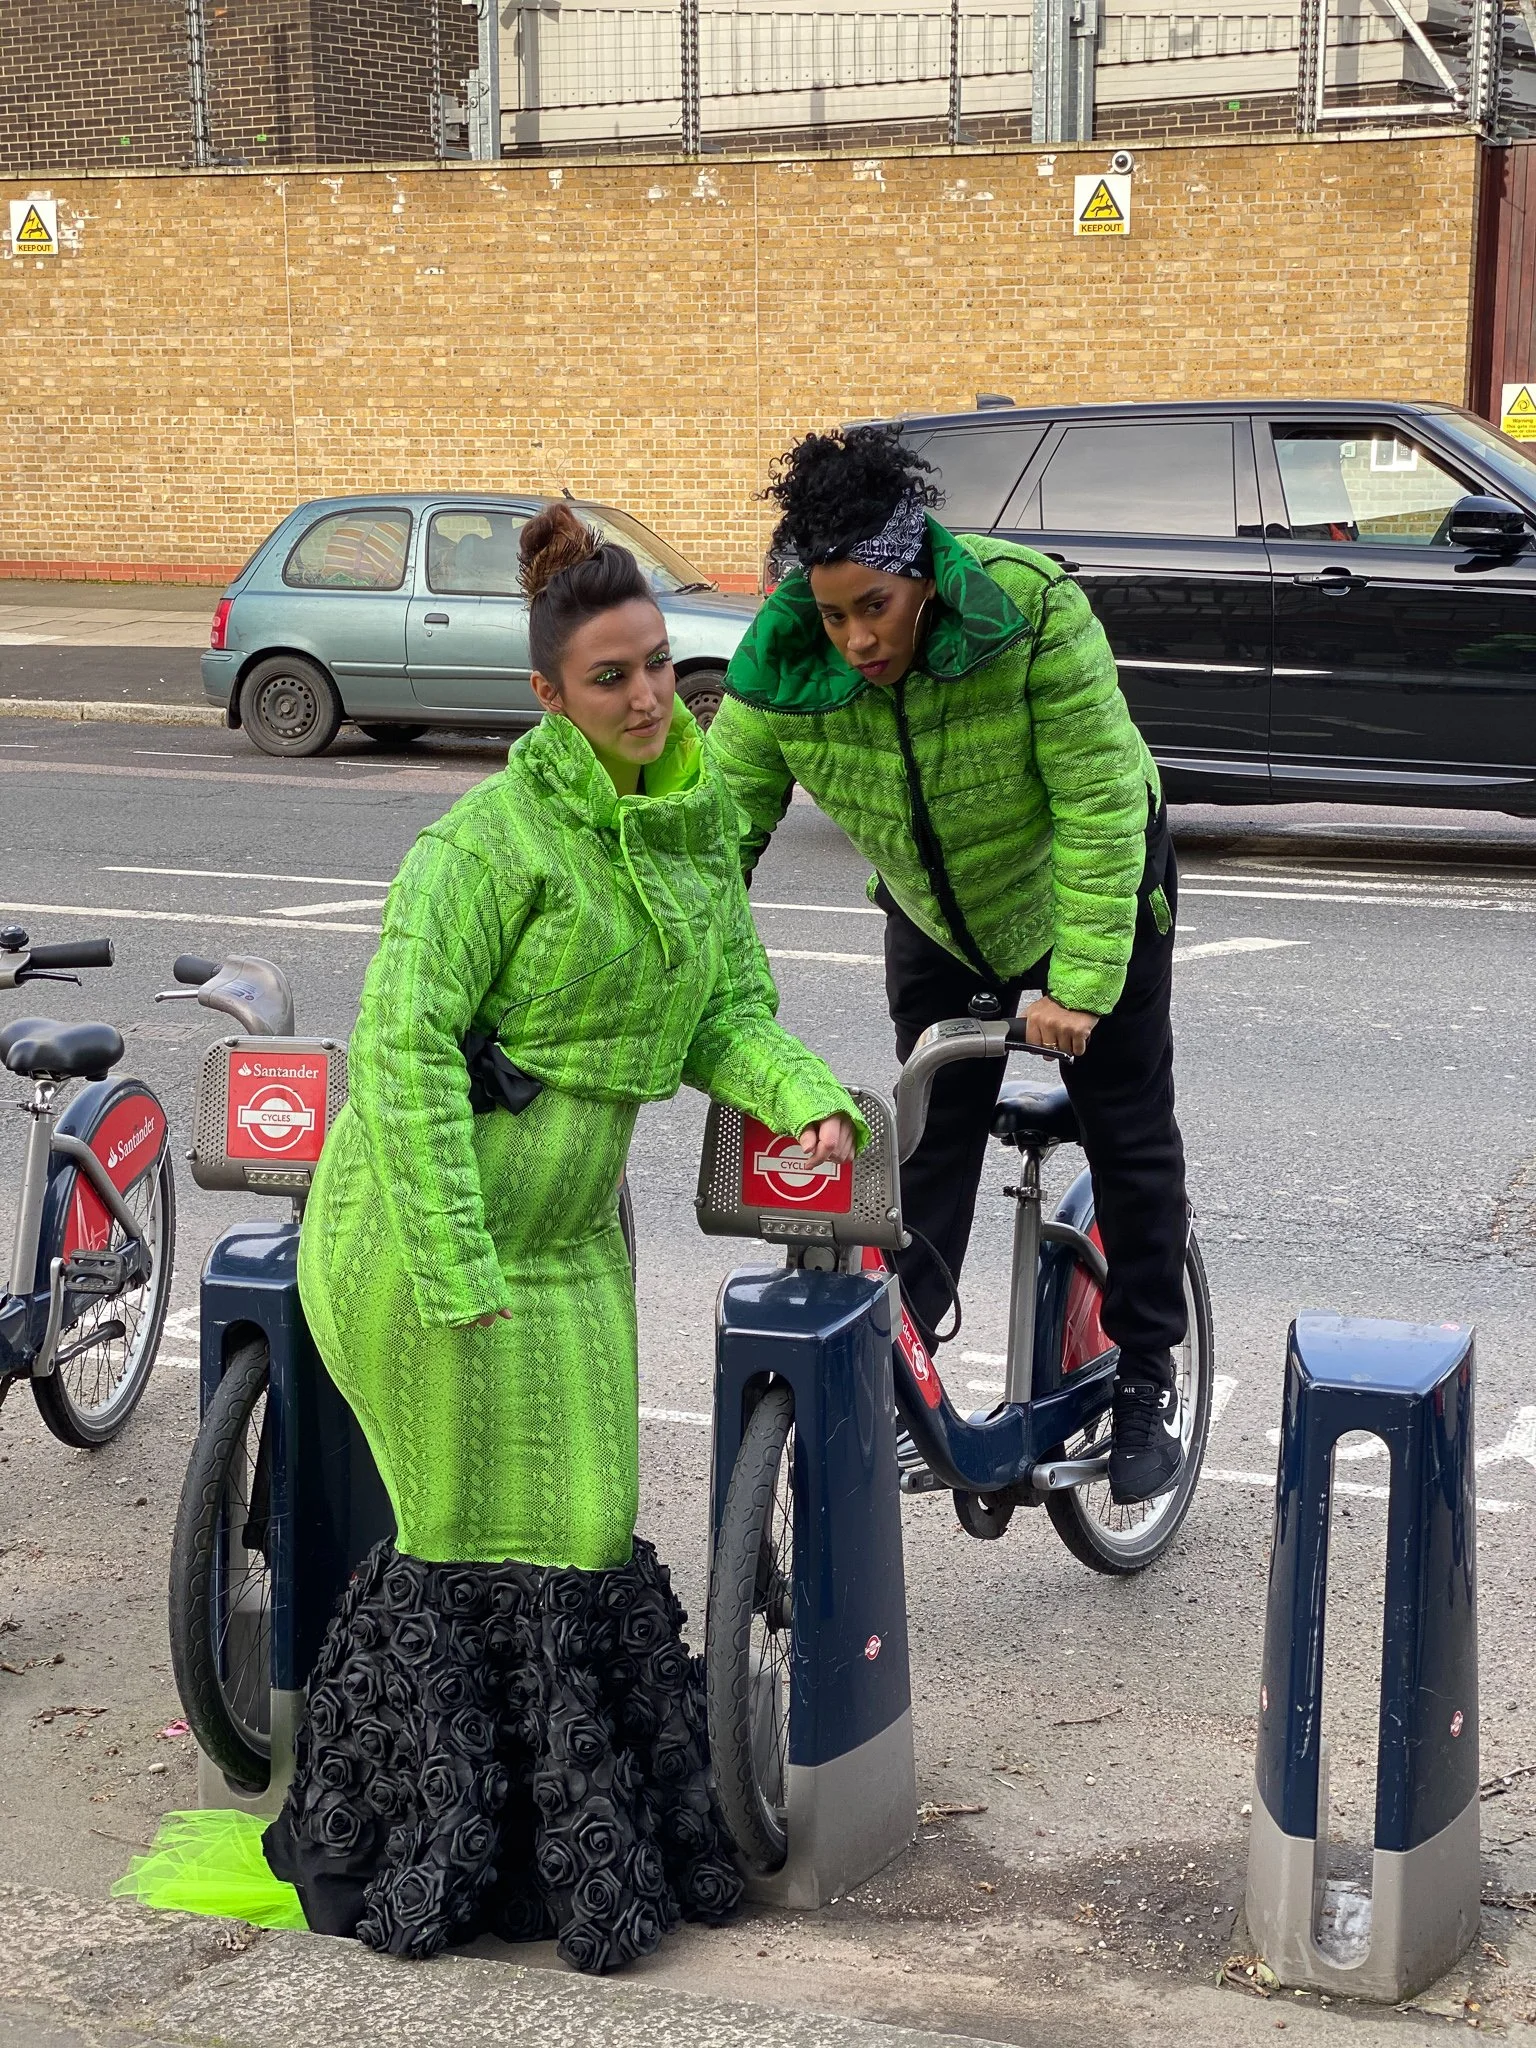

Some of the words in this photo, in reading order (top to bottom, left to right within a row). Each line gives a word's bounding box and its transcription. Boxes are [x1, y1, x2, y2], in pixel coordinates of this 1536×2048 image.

[1081, 224, 1103, 232] KEEP
[1103, 223, 1122, 232] OUT
[253, 1063, 319, 1079] Santander
[261, 1113, 291, 1122] CYCLES
[117, 1115, 155, 1162] Santander
[780, 1161, 807, 1170] CYCL
